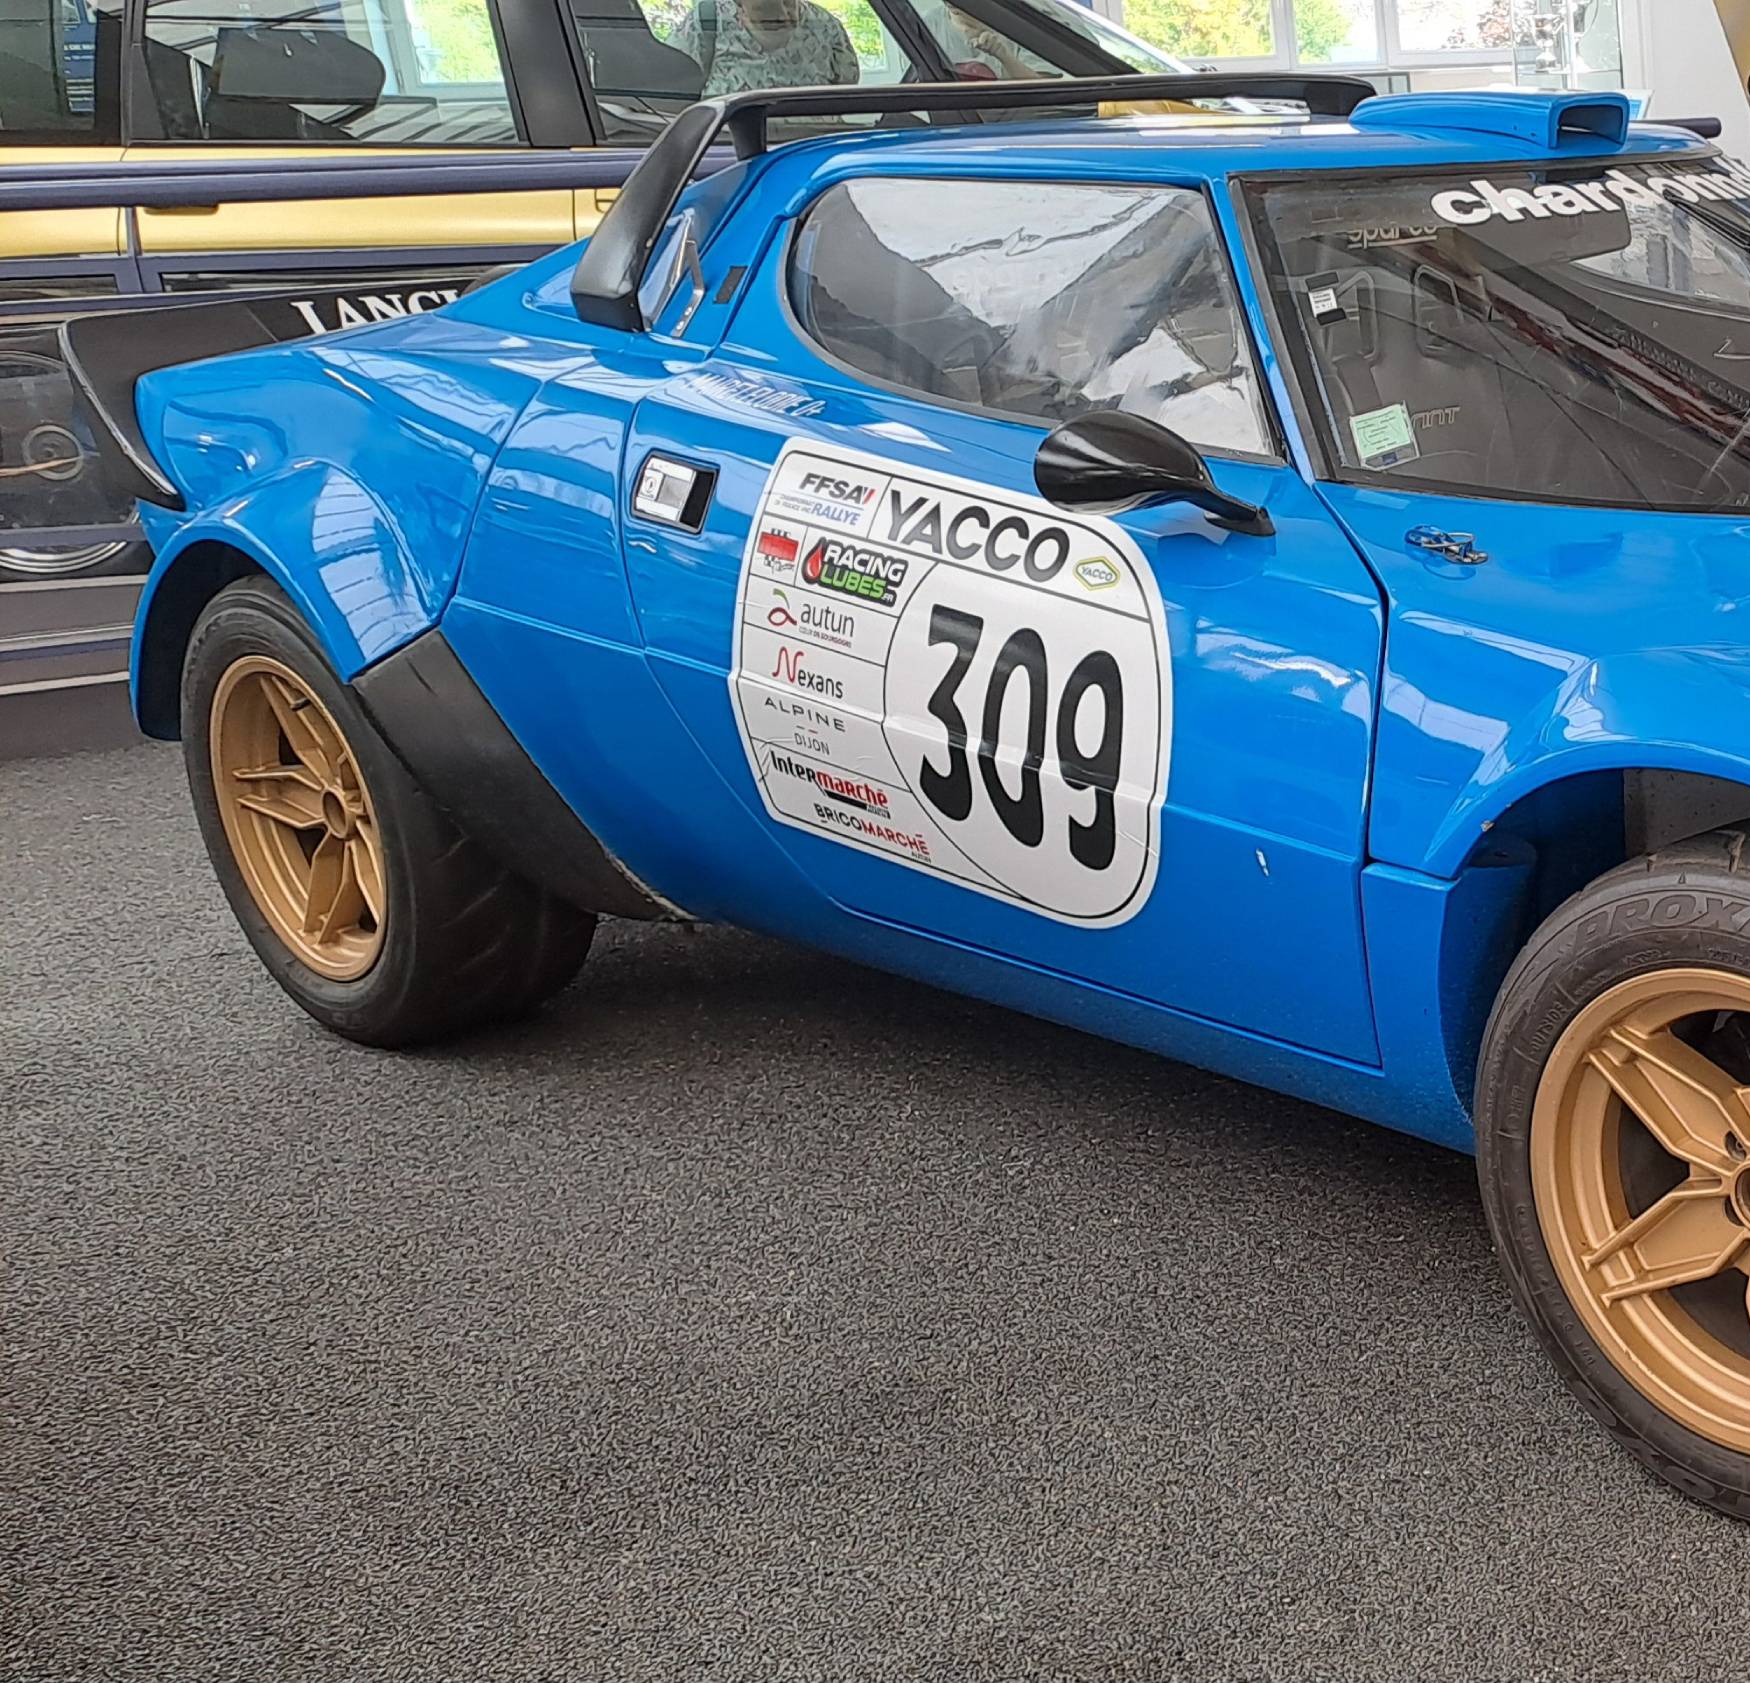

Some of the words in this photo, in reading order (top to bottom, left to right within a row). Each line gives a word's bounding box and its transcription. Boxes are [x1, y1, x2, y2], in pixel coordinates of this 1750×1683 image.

[798, 472, 866, 505] FFSA
[811, 503, 861, 526] RALLYE
[888, 489, 1071, 583] YACCO
[822, 544, 907, 583] RACING
[1081, 565, 1114, 582] YACCO
[800, 603, 855, 638] autun
[772, 646, 845, 699] Nexans
[764, 697, 847, 732] ALPINE
[794, 732, 831, 756] DIJON
[919, 603, 1124, 871] 309
